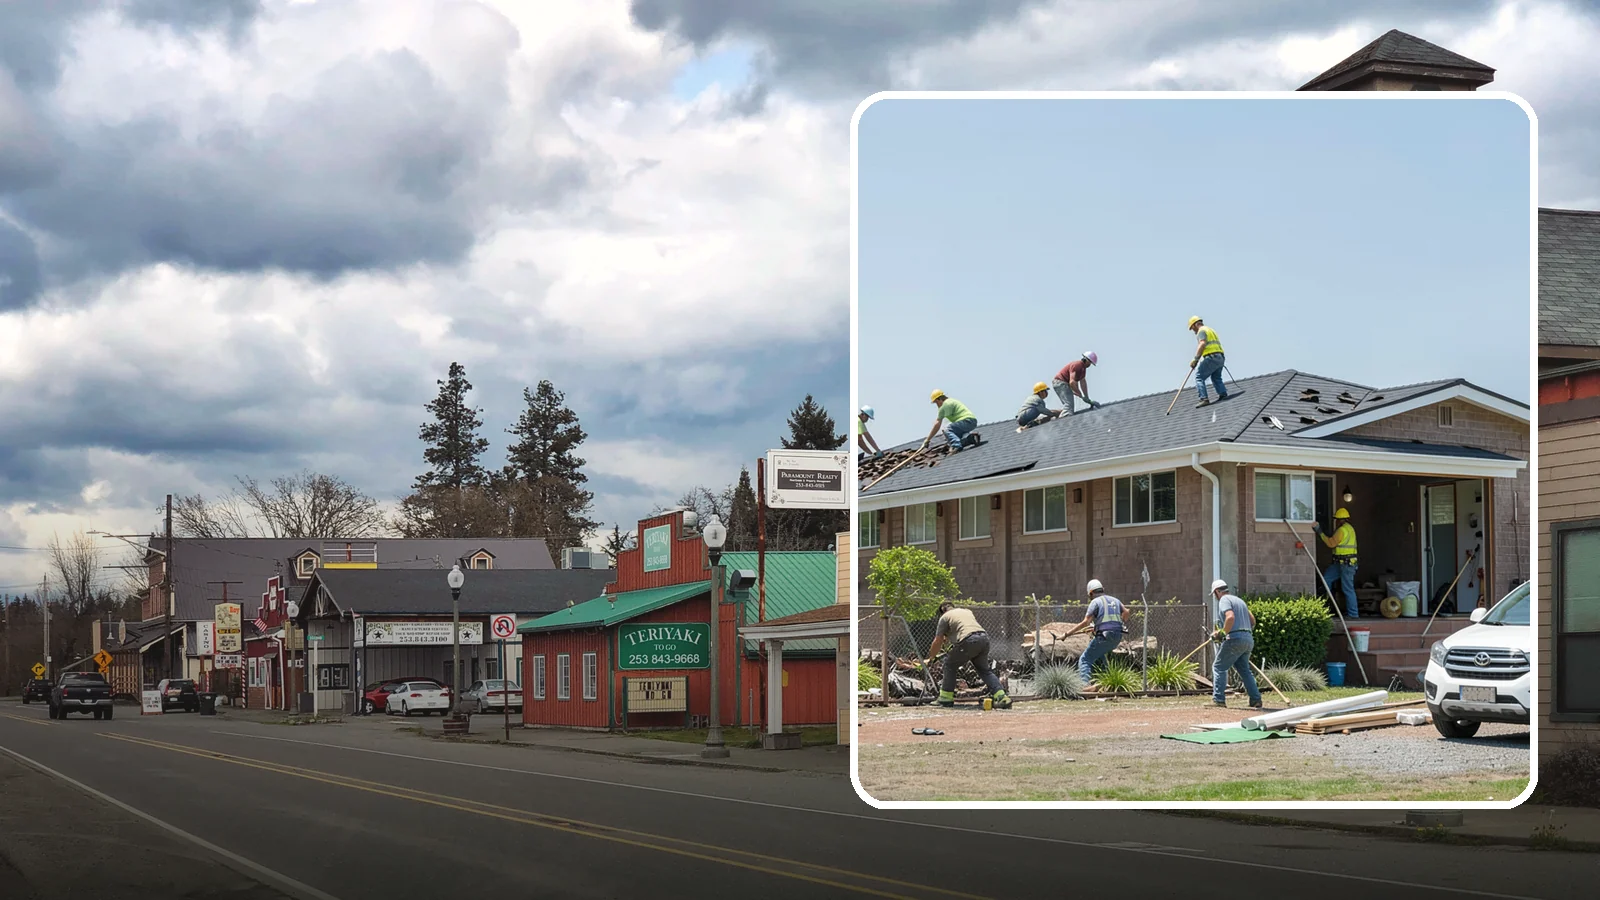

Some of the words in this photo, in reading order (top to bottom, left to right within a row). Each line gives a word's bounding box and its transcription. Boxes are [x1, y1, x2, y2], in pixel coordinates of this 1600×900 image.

[817, 472, 839, 480] REALTY
[624, 627, 702, 646] TERIYAKI
[629, 654, 648, 664] 253
[651, 654, 700, 664] 843-9668
